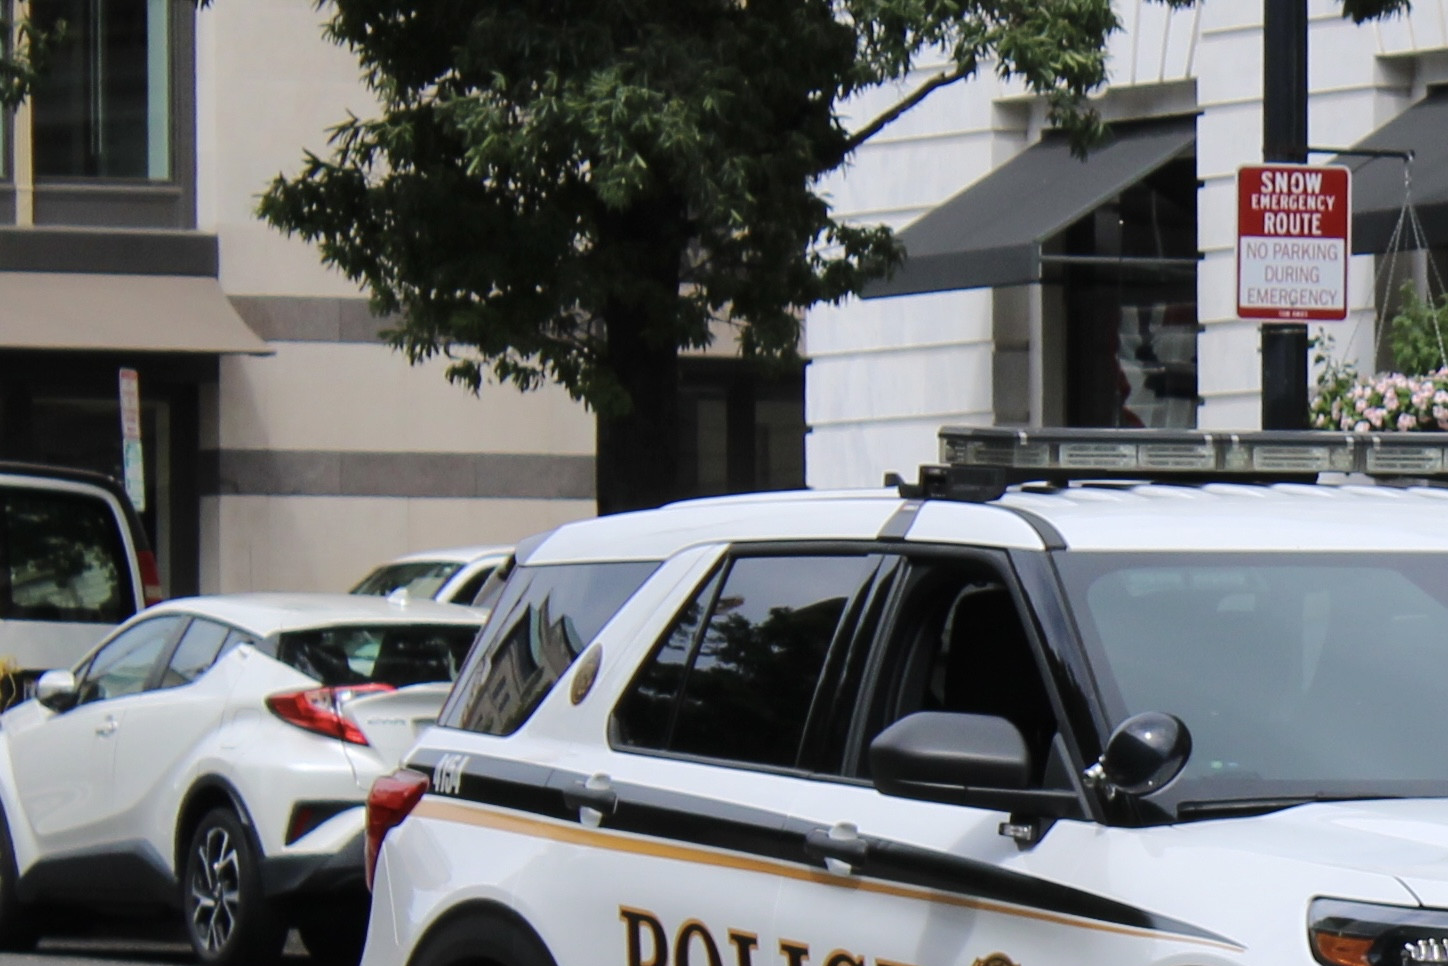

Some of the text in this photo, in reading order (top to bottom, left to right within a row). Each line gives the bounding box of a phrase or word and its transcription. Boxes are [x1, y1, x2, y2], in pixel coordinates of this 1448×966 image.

[1261, 171, 1322, 194] SNOW
[1251, 194, 1335, 211] EMERGENCY
[1264, 212, 1322, 235] ROUTE
[1246, 243, 1338, 261] NO PARKING
[1265, 266, 1320, 283] DURING
[1247, 288, 1337, 306] EMERGENCY
